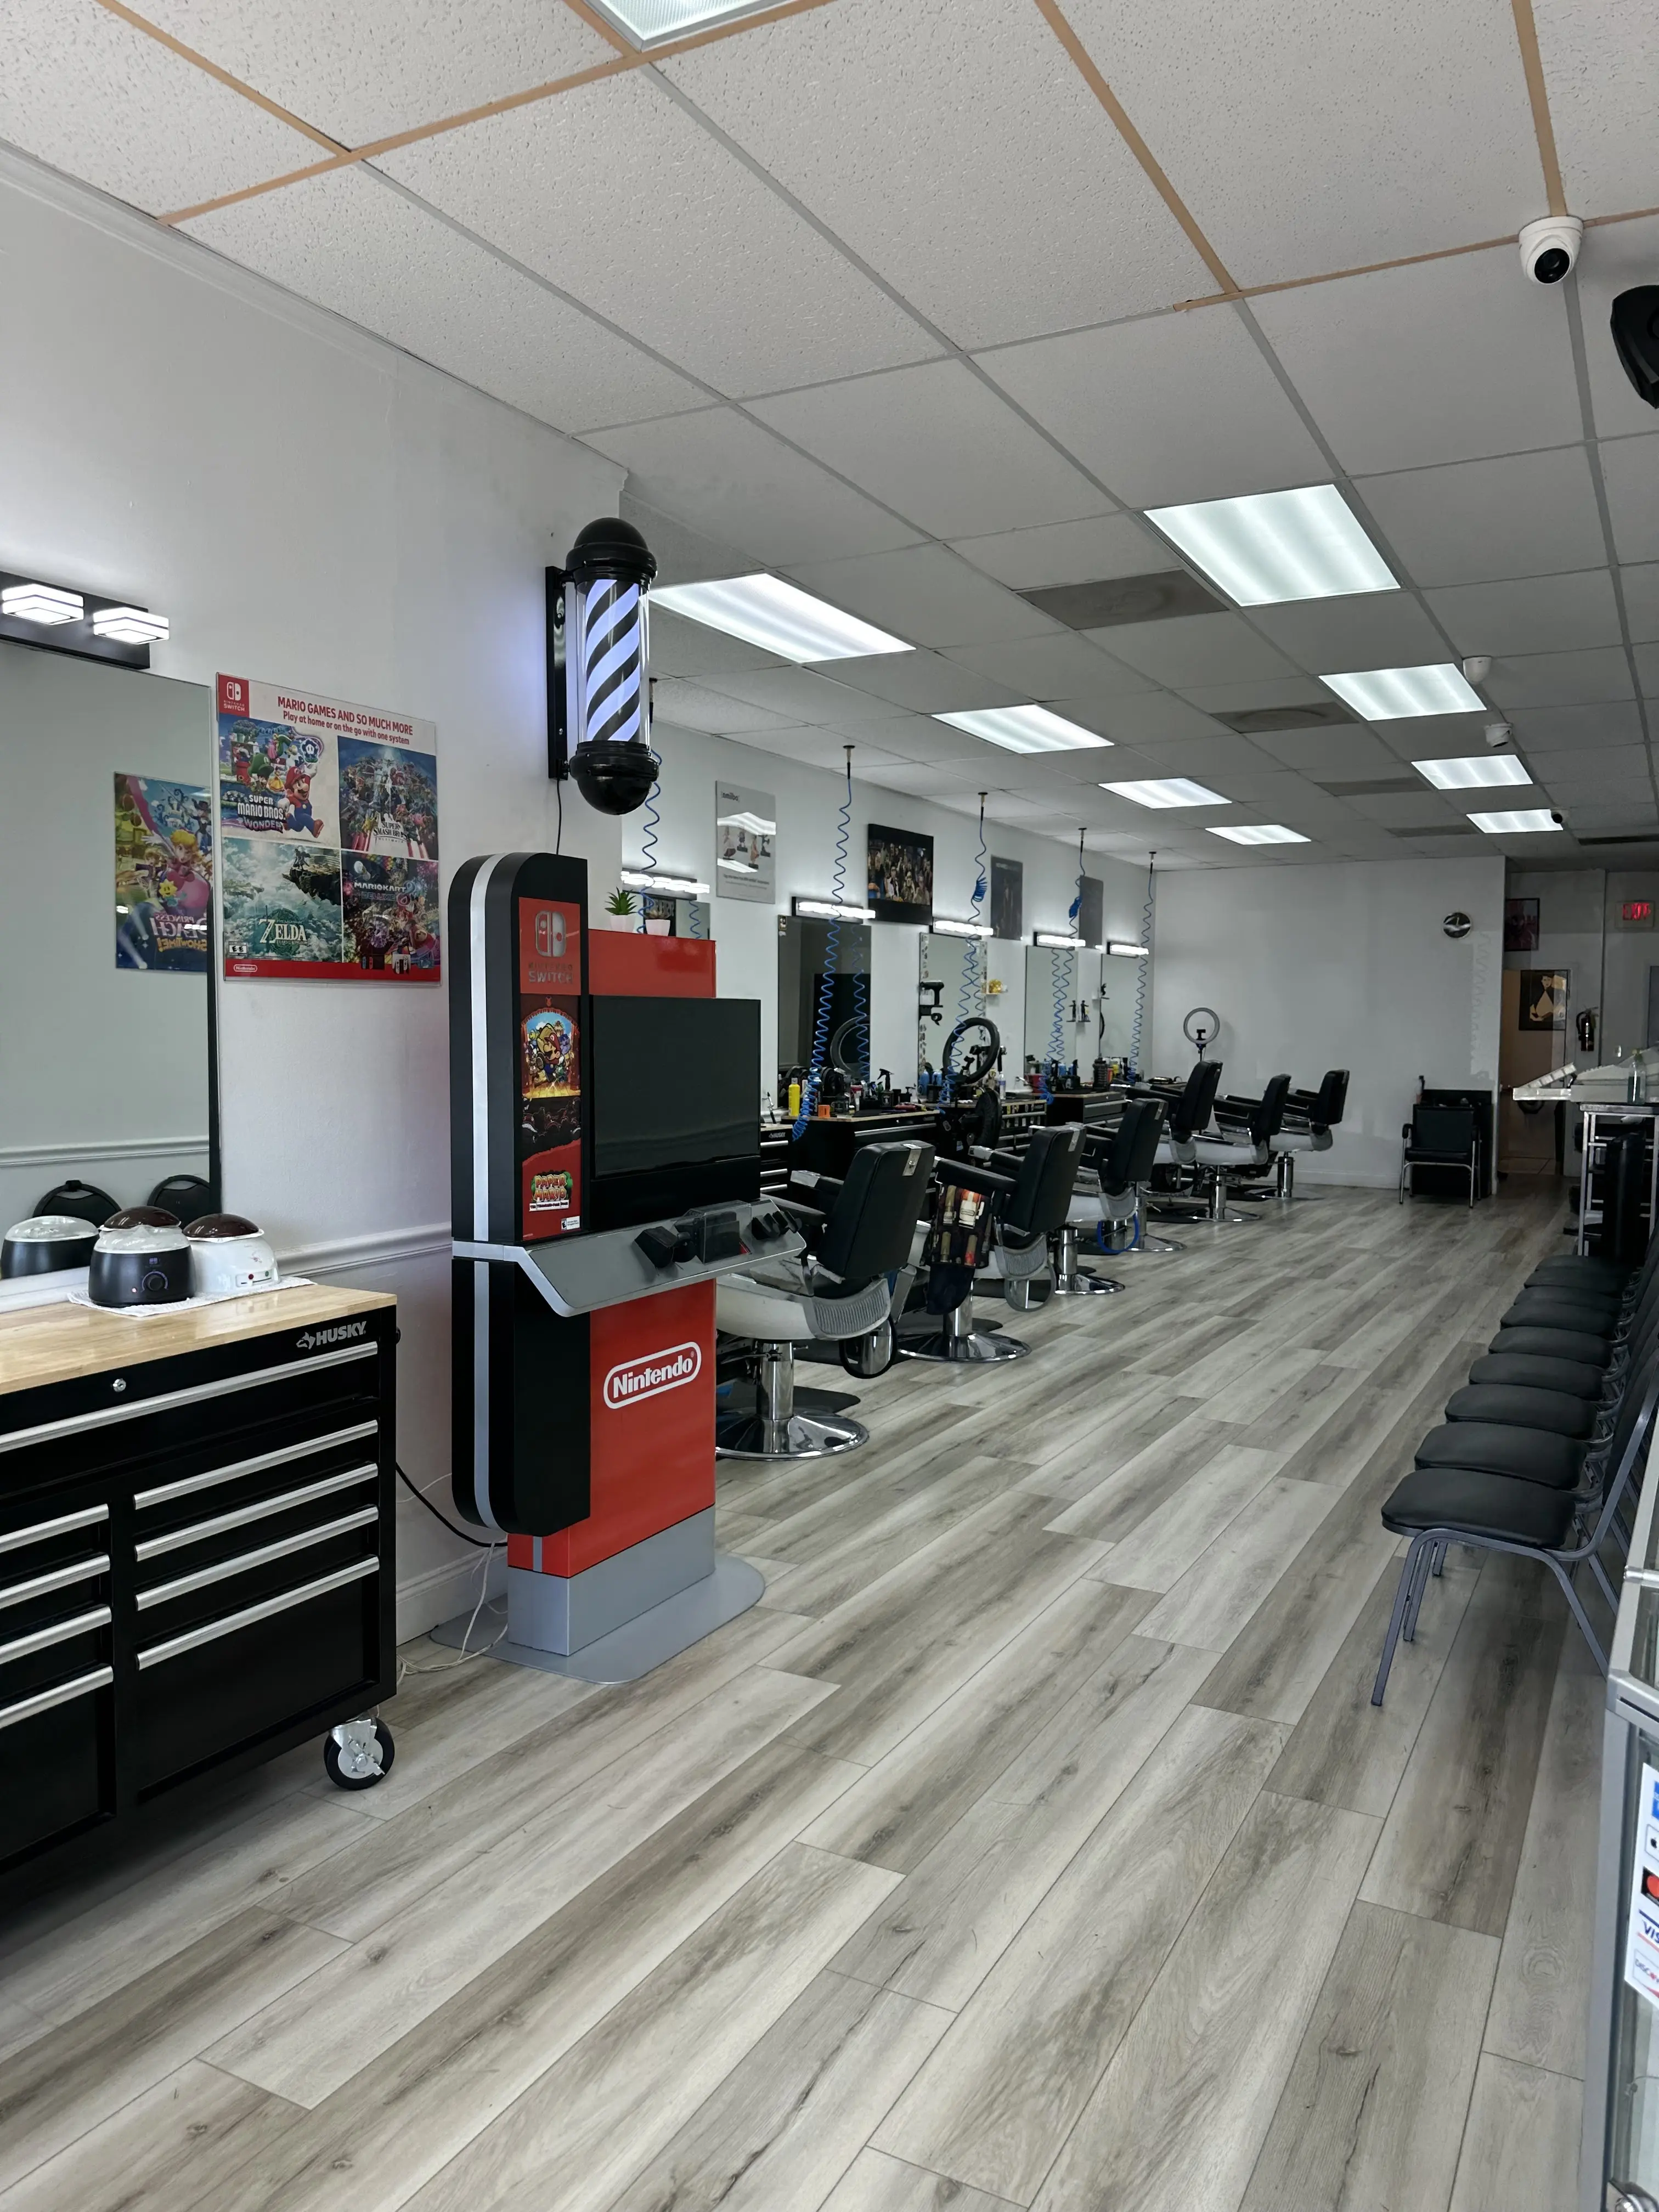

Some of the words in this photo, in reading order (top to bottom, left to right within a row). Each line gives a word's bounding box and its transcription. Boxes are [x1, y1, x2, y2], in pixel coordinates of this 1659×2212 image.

[224, 703, 245, 712] SWITCH
[278, 696, 306, 712] MARIO
[308, 703, 336, 718] GAMES
[338, 710, 354, 723] AND
[357, 714, 367, 725] SO
[369, 716, 391, 730] MUCH
[392, 721, 413, 735] MORE
[283, 710, 297, 723] Play
[308, 715, 325, 727] home
[342, 724, 353, 733] the
[354, 728, 362, 736] go
[363, 728, 376, 738] with
[377, 732, 388, 741] one
[389, 735, 410, 745] system
[249, 794, 273, 805] SUPER
[238, 802, 262, 817] MARIO
[264, 806, 286, 820] BROS.
[243, 816, 283, 830] WONDER
[381, 821, 401, 830] SUPER
[374, 827, 392, 836] SMASH
[361, 891, 396, 901] DELUXE
[258, 918, 307, 943] ZELDA
[528, 970, 573, 984] SWITCH
[535, 1173, 567, 1188] PAPER
[534, 1187, 567, 1201] MARIO
[315, 1321, 366, 1346] HUSKY
[613, 1355, 693, 1398] Nintendo
